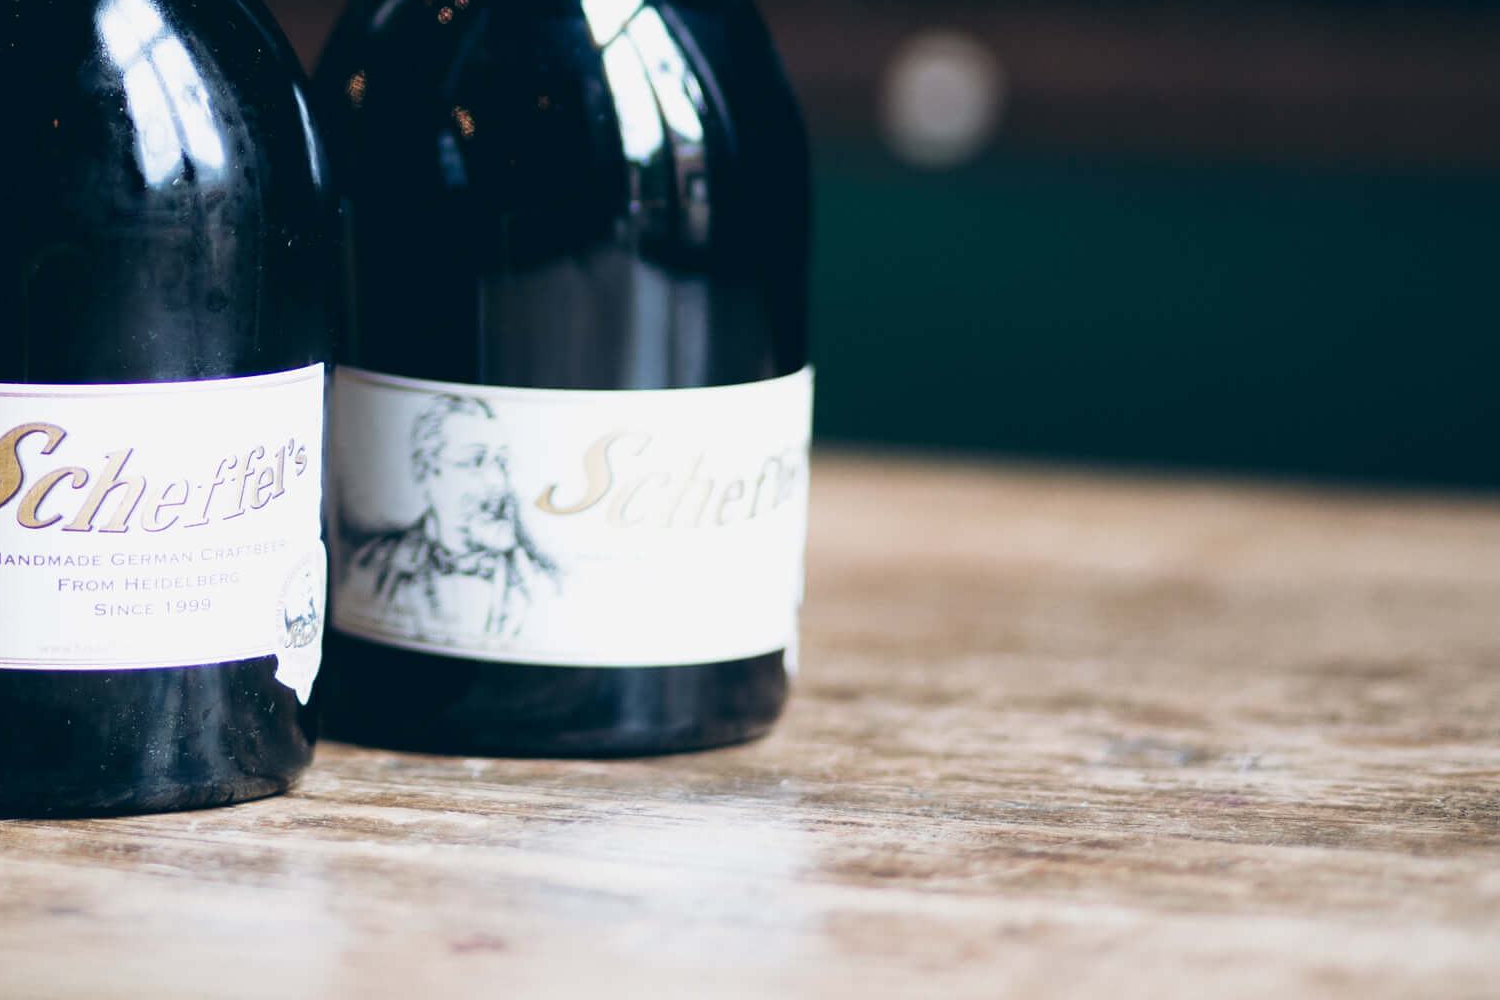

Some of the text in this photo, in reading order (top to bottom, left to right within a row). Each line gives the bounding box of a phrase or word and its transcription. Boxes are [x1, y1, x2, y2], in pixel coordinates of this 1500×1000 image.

[111, 551, 193, 567] GERMAN
[57, 571, 241, 592] FROM HEIDELBERG
[94, 598, 211, 616] SINCE 1999
